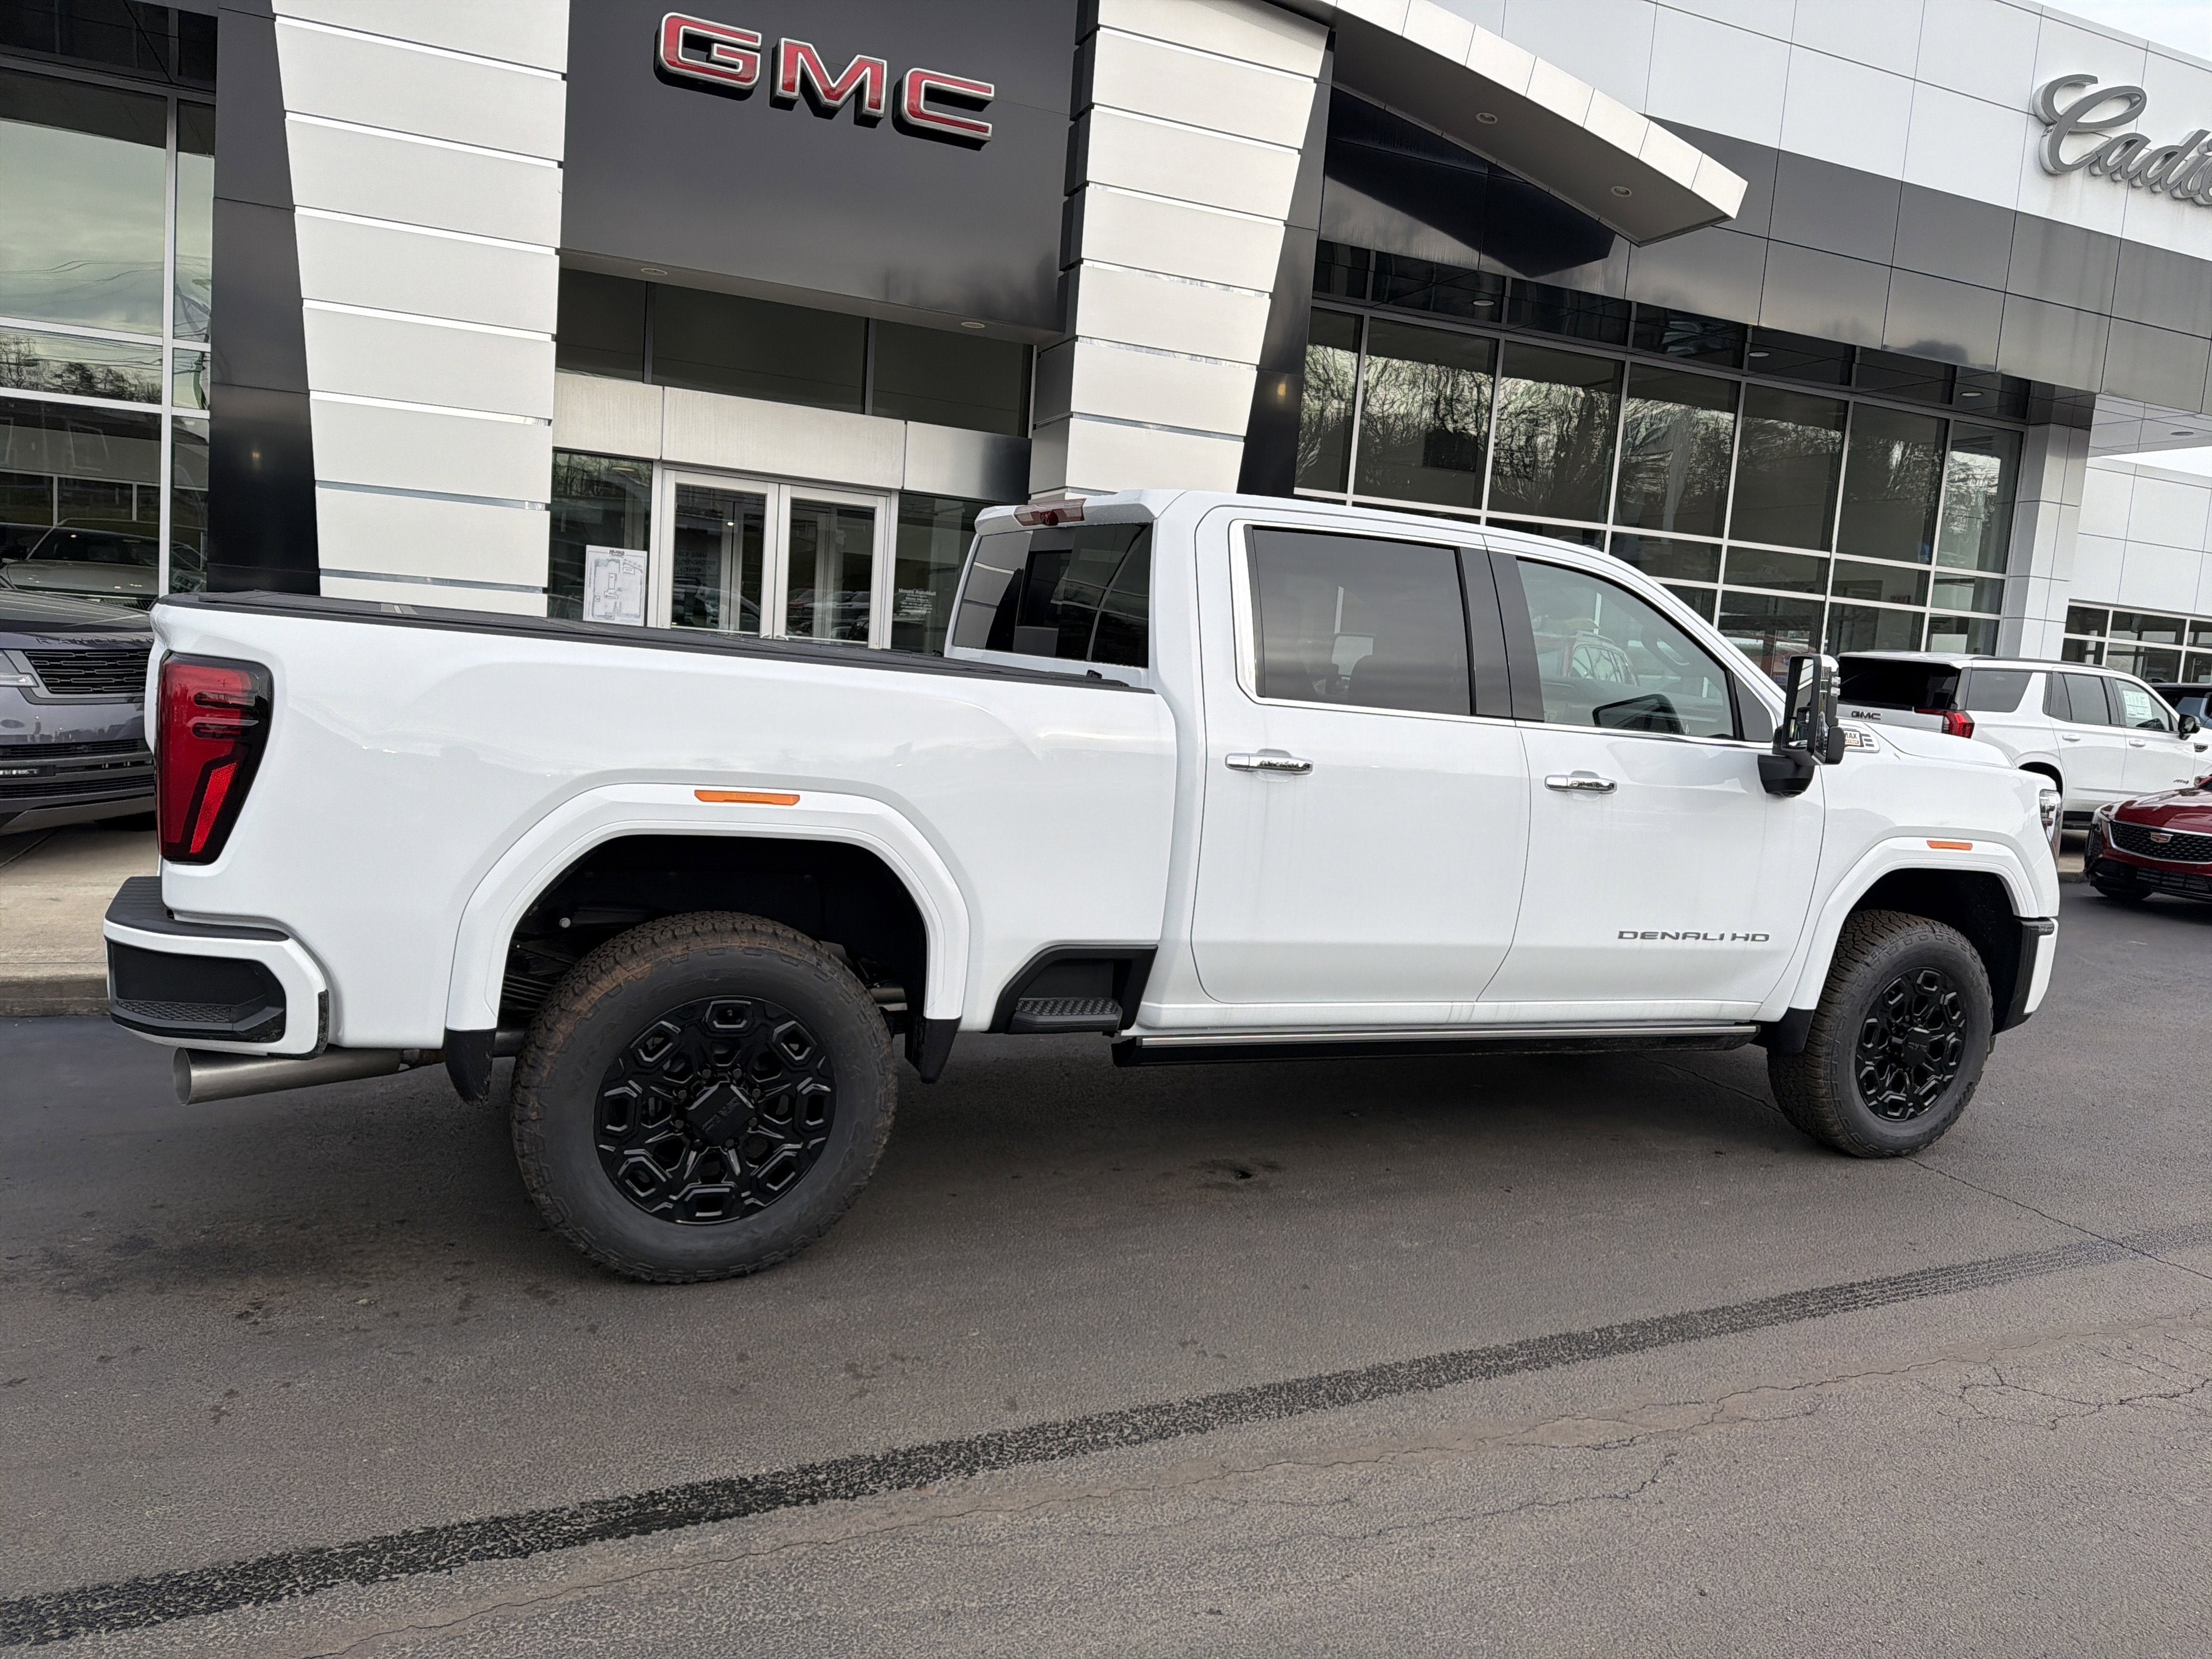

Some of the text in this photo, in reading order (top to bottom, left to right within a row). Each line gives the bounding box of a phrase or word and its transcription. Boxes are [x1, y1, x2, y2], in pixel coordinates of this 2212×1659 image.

[655, 12, 995, 147] GMC
[2032, 74, 2212, 205] Cadi
[1851, 710, 1882, 720] GMC
[1618, 930, 1770, 942] DENALI HD
